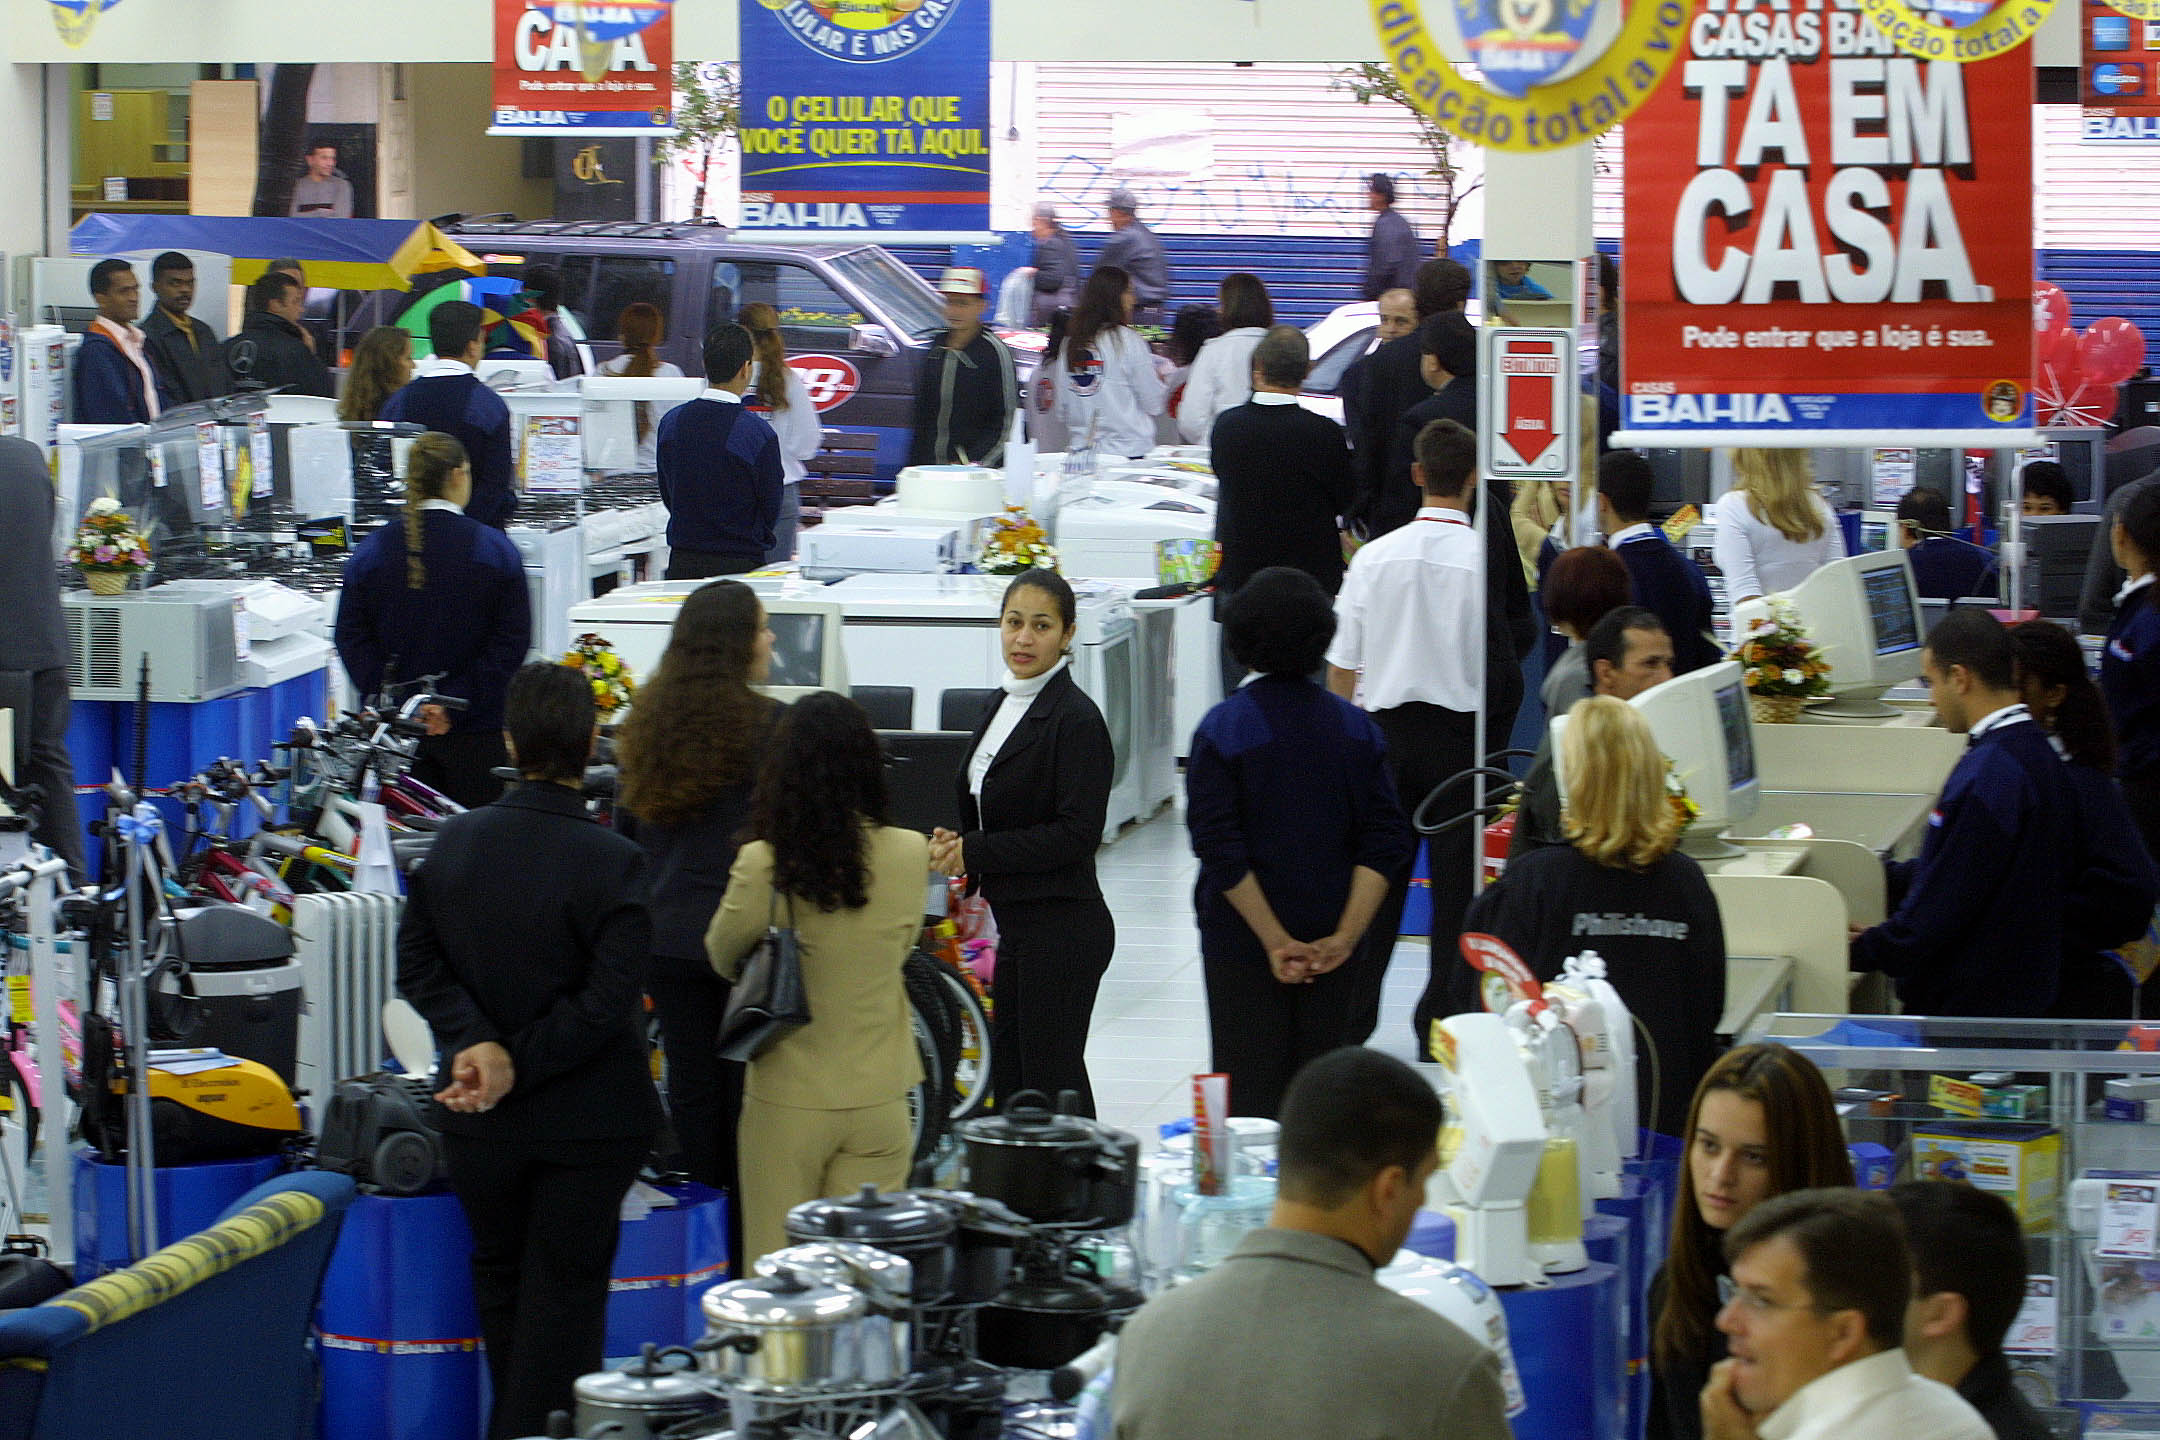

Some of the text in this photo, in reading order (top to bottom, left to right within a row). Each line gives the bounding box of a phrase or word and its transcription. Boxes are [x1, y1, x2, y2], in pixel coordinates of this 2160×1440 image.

[515, 9, 658, 72] CAA.
[1690, 11, 1822, 58] CASAS
[1952, 17, 2023, 58] total
[767, 96, 962, 127] O CELULAR QUE
[1524, 75, 1630, 147] total
[1626, 59, 1657, 90] a
[1829, 57, 1973, 165] EM
[738, 122, 806, 154] VOCÊ
[810, 129, 879, 158] QUER
[882, 121, 917, 154] TÁ
[738, 203, 869, 227] BAHIA
[1672, 166, 1995, 305] CASA.
[1682, 324, 1994, 351] Pode entrar que a loja é sua.
[1630, 393, 1793, 423] BAHIA
